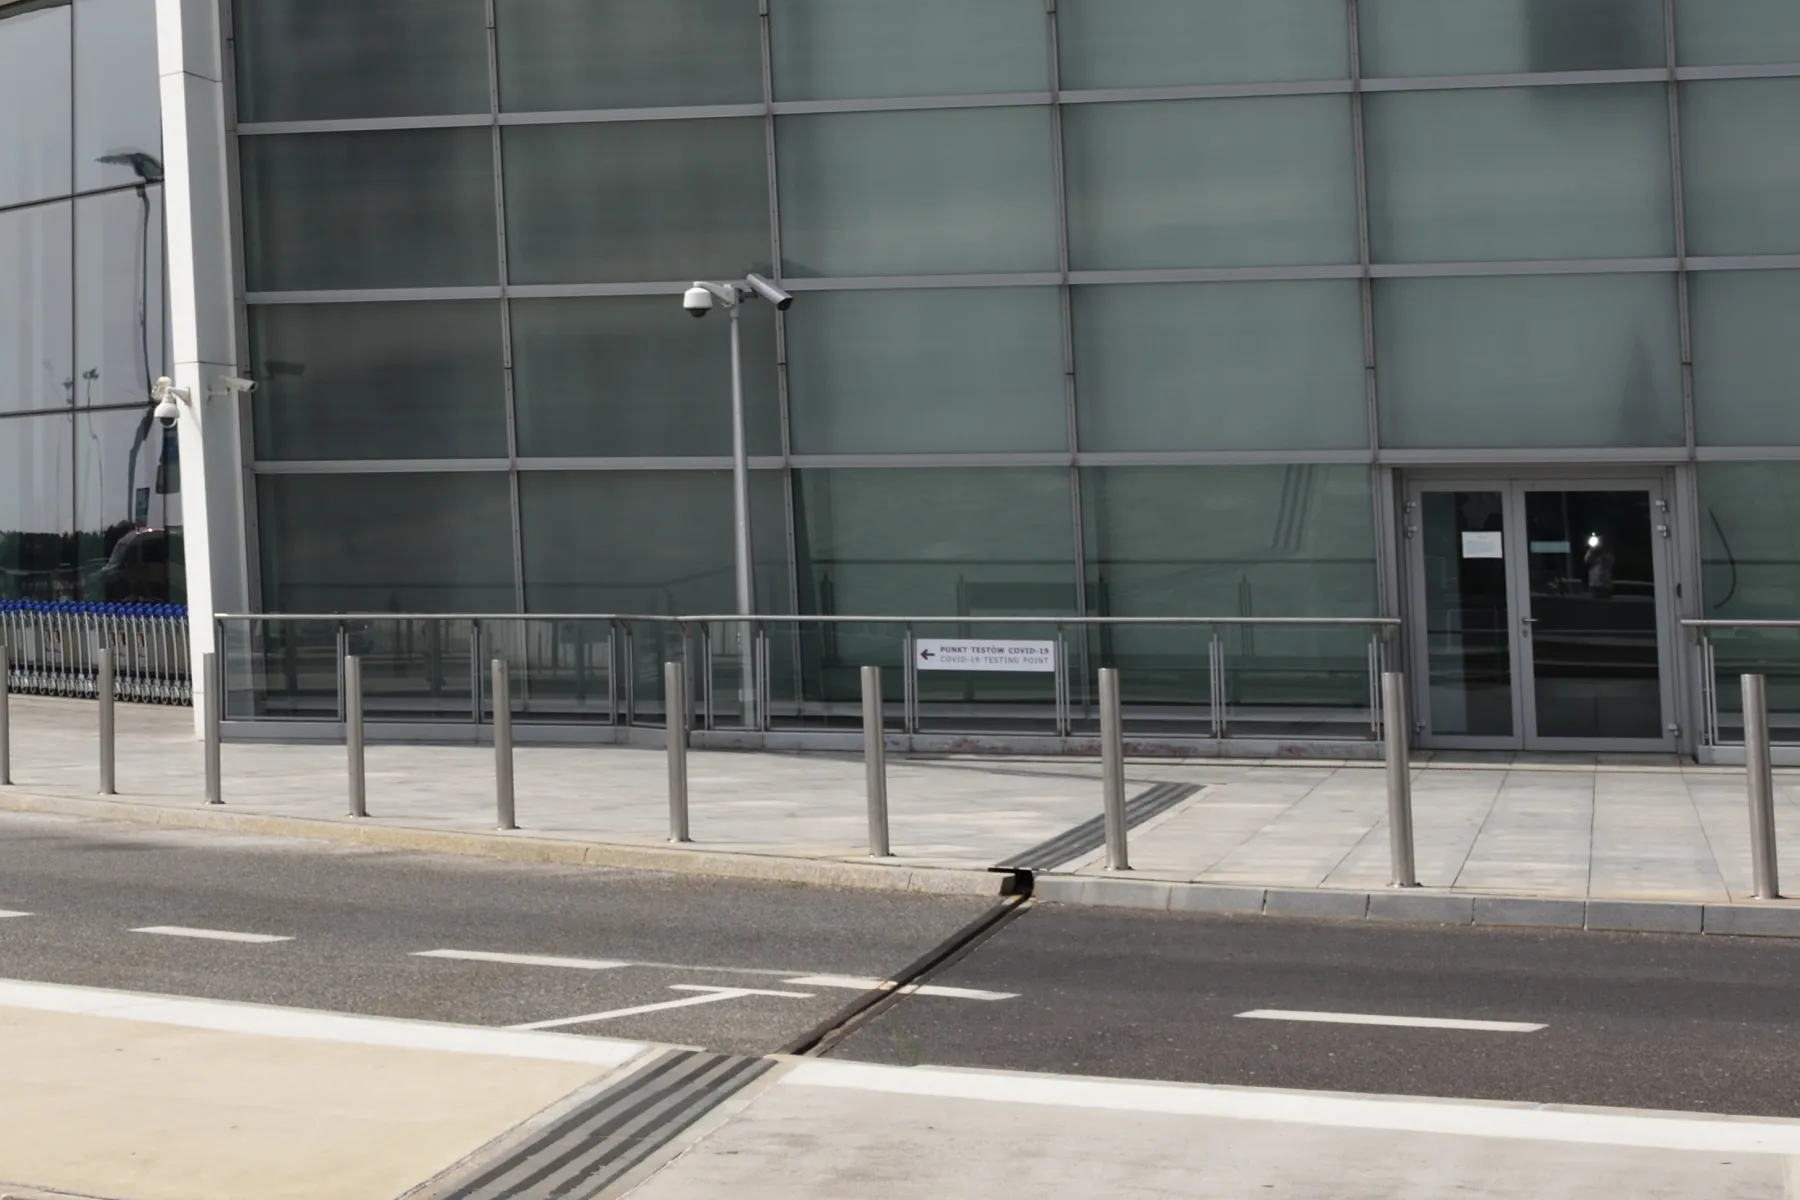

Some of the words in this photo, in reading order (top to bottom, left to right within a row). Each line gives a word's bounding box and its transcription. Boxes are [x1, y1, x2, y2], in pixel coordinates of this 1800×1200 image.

[972, 645, 1004, 654] TESTÓW
[1009, 647, 1049, 655] COVID-19
[940, 655, 980, 663] COVID-19
[985, 656, 1019, 664] TESTING
